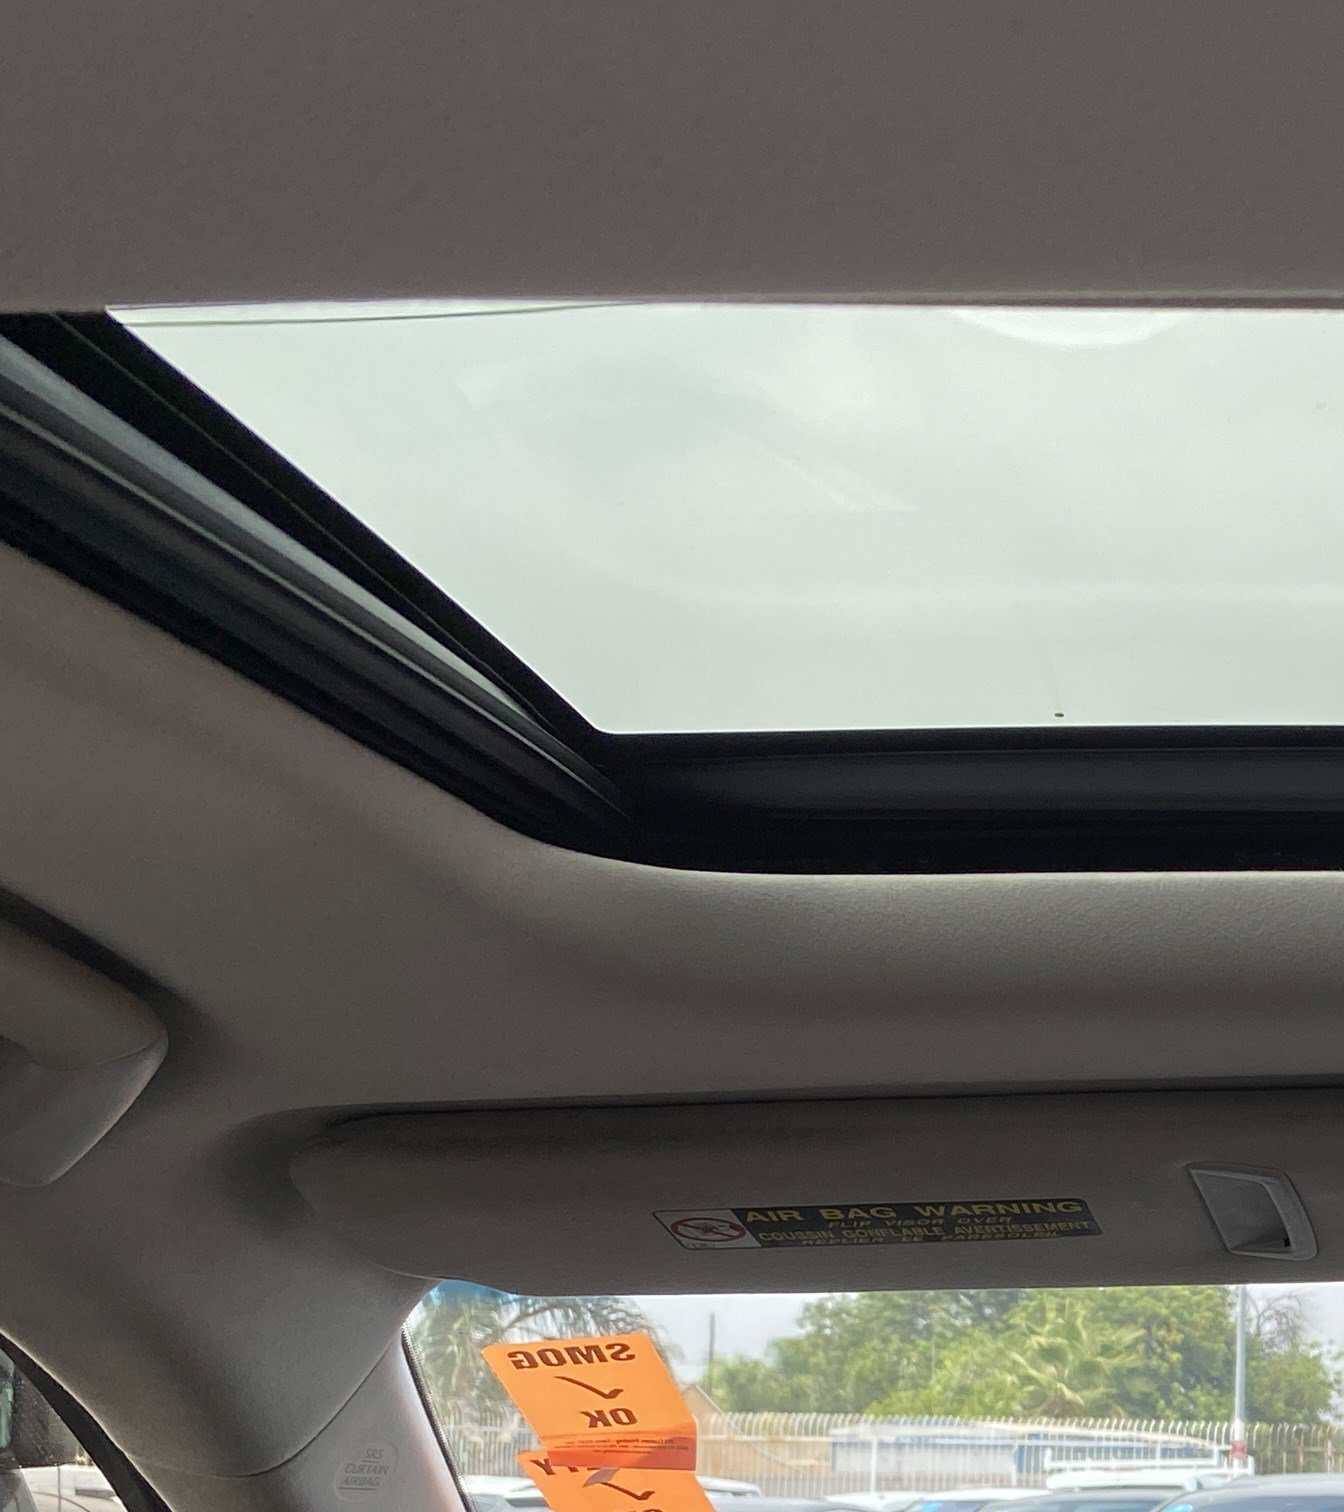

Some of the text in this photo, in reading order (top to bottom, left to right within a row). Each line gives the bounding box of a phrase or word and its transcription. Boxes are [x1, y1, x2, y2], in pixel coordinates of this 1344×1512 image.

[745, 1200, 1083, 1223] AIR BAG WARNING
[953, 1221, 1091, 1236] AVERTISSEMENT
[366, 1447, 385, 1459] SRS
